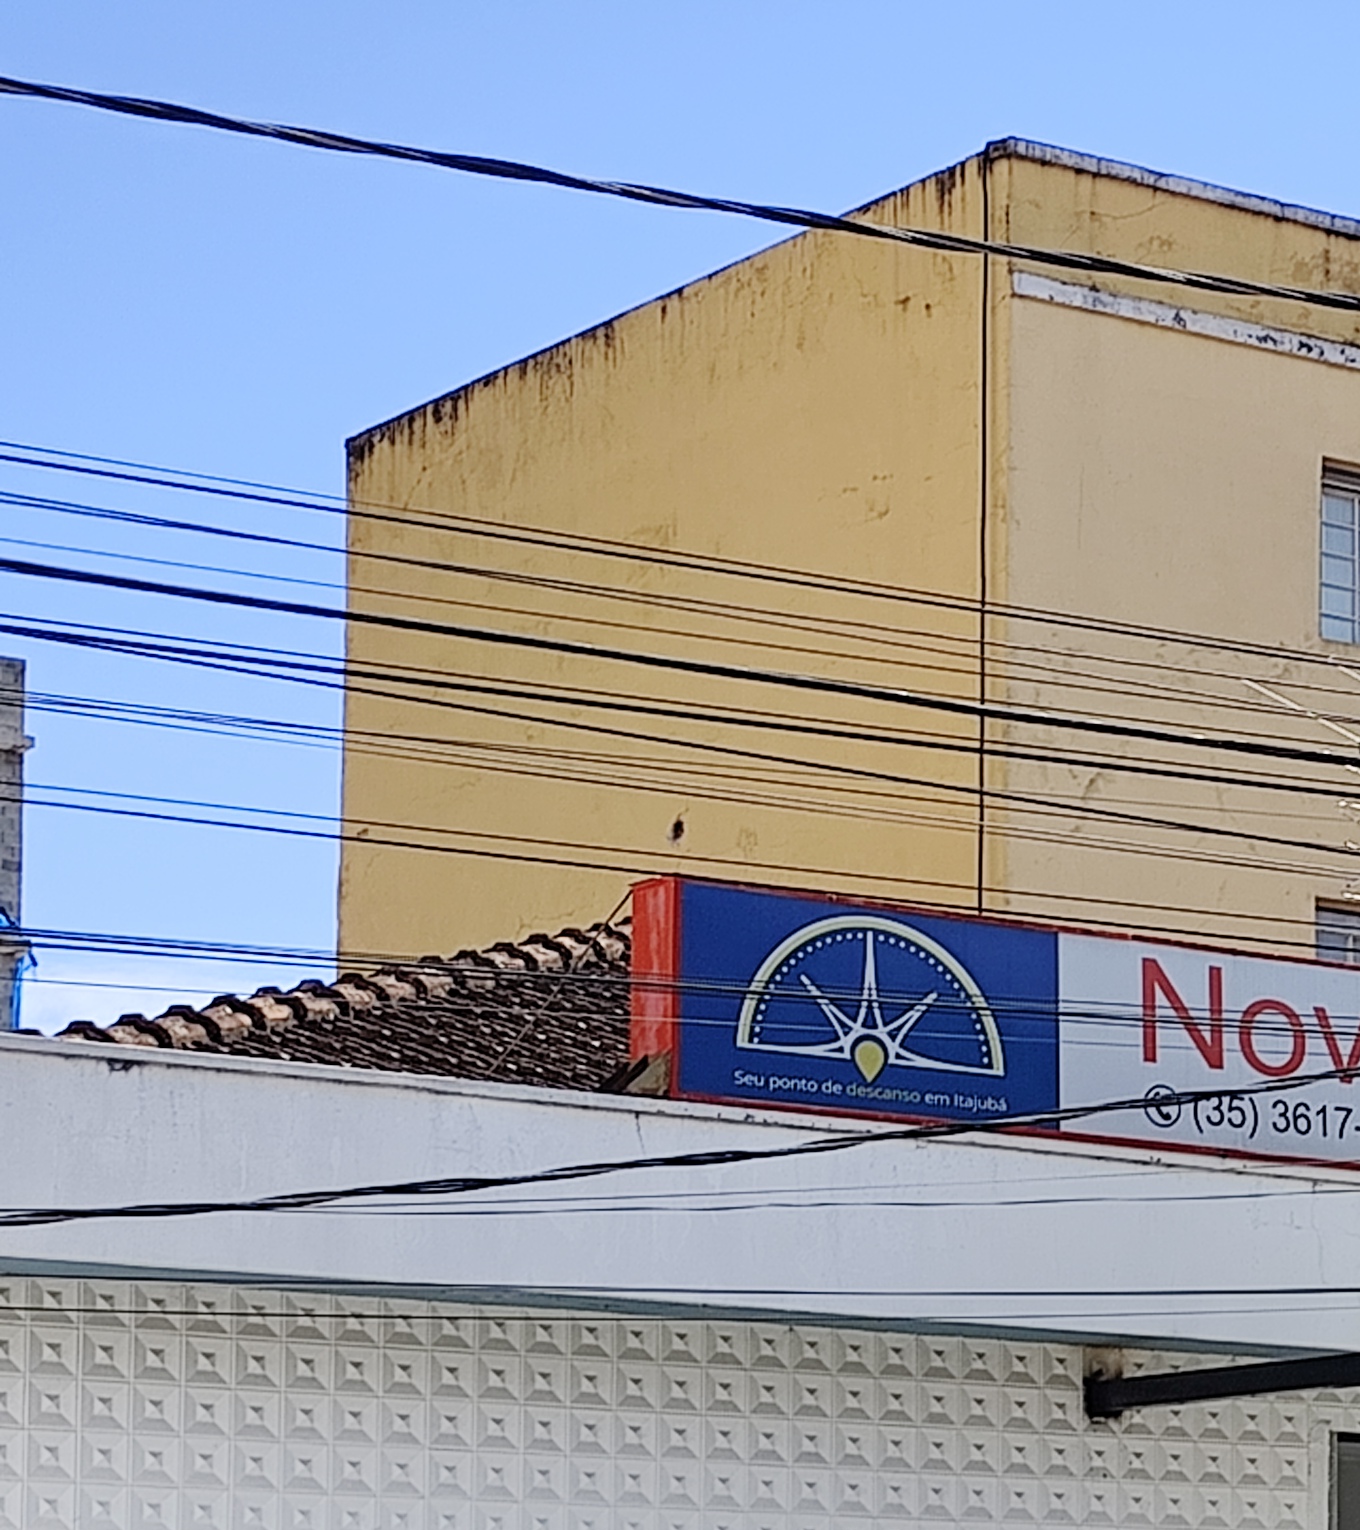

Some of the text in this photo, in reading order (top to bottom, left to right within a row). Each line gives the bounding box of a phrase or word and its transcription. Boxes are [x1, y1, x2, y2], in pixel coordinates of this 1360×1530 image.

[733, 1070, 1007, 1113] Seu ponto de descanso em Itajubá
[1193, 1096, 1258, 1139] (35)
